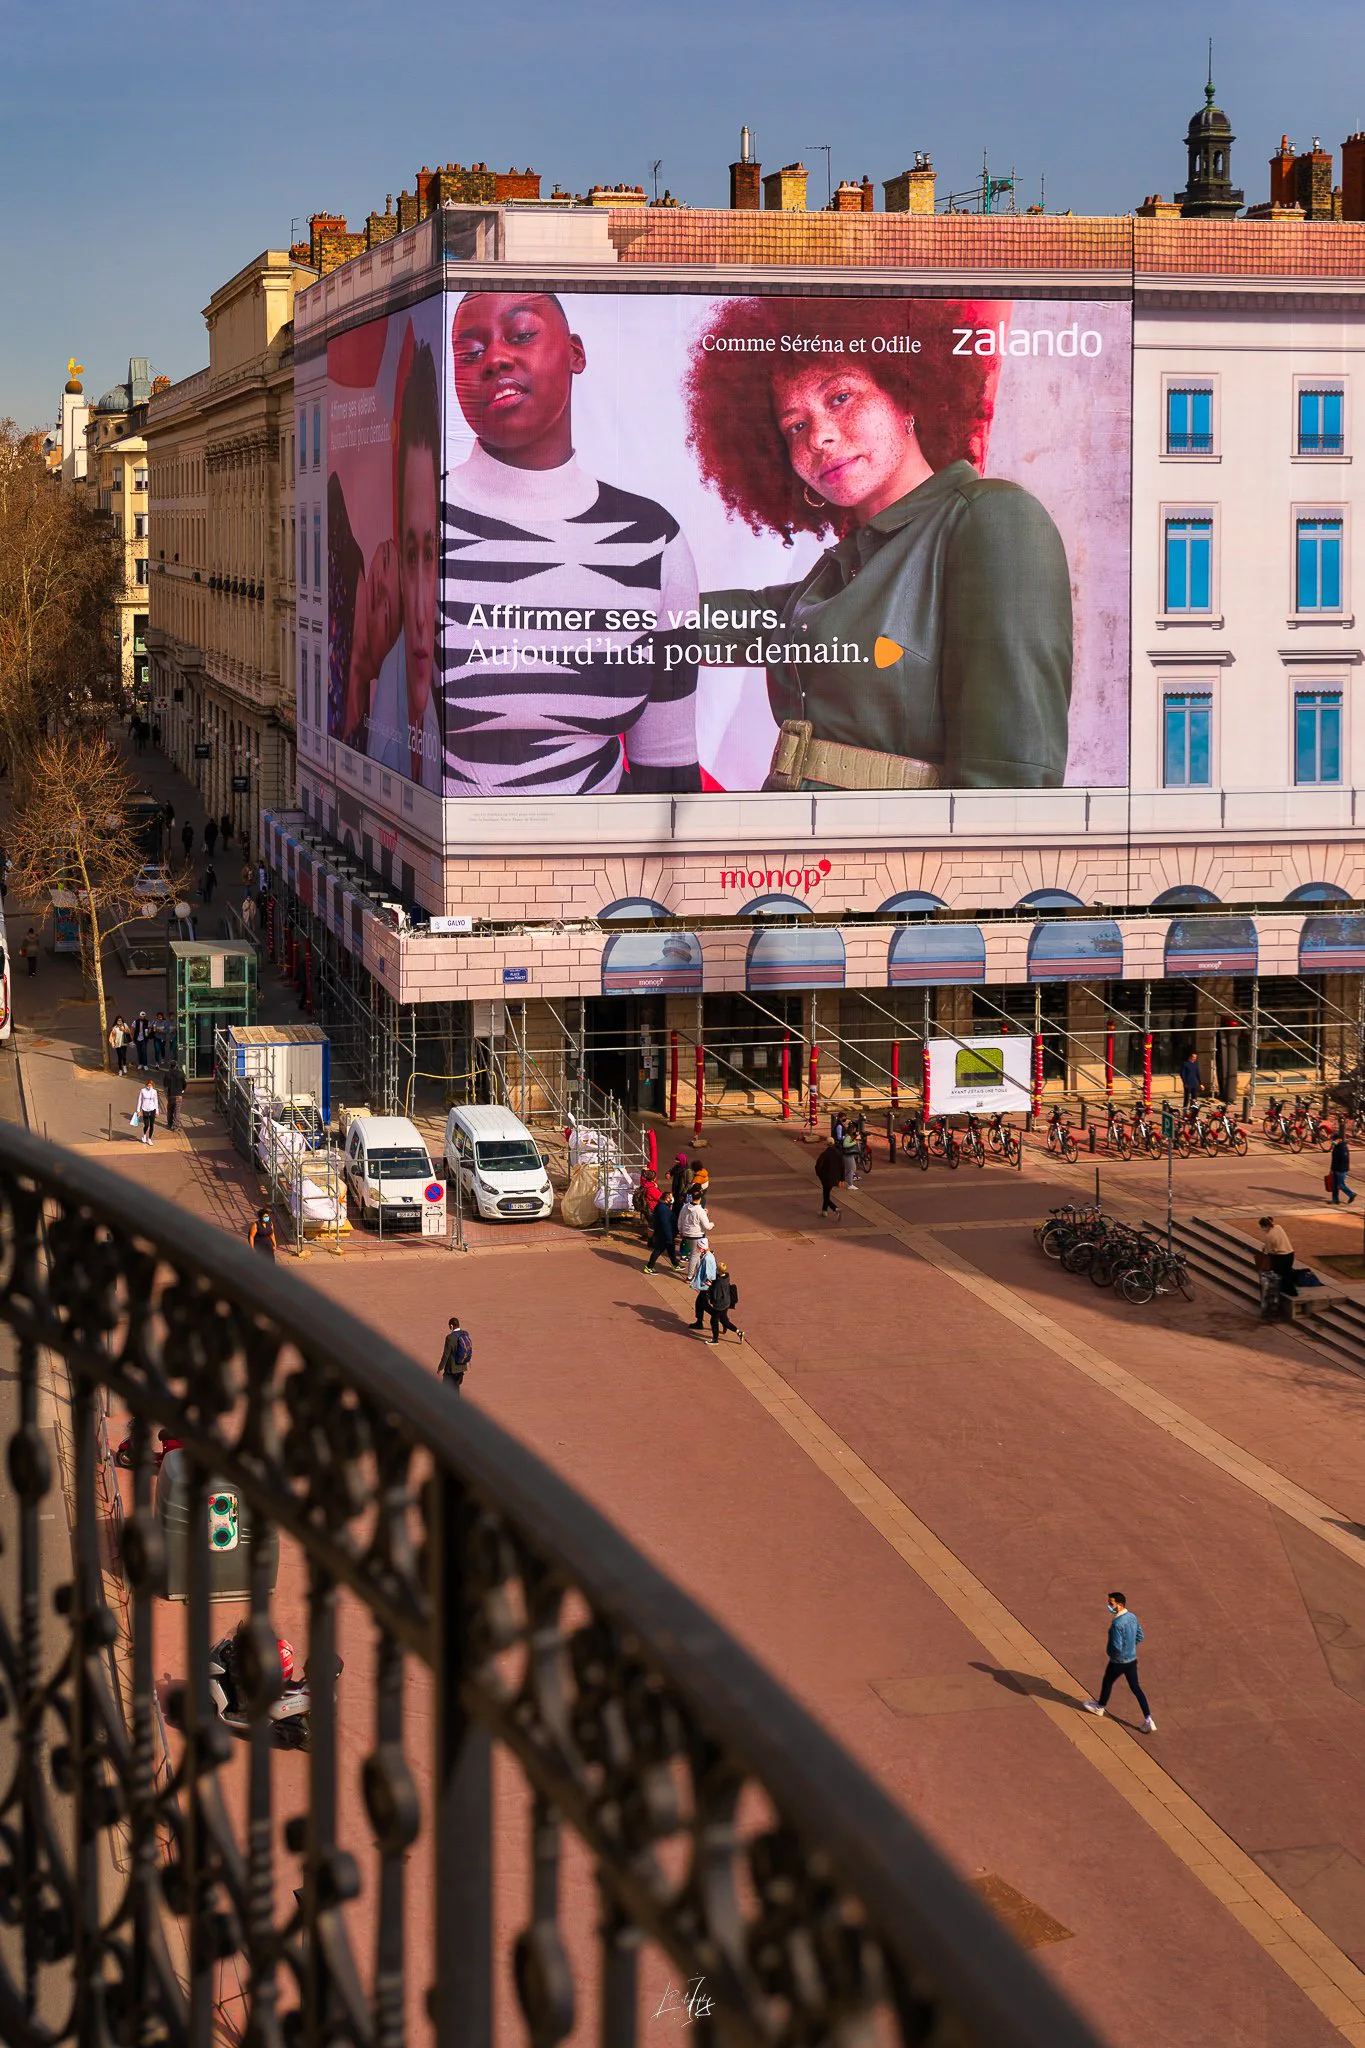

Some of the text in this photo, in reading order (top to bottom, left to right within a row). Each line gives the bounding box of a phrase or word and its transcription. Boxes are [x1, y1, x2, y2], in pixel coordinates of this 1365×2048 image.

[702, 333, 922, 355] Comme Séréna et Odile
[952, 321, 1102, 358] zalando
[466, 603, 787, 631] Affirmer ses valeurs.
[465, 636, 870, 672] Aujourd'hui pour demain.
